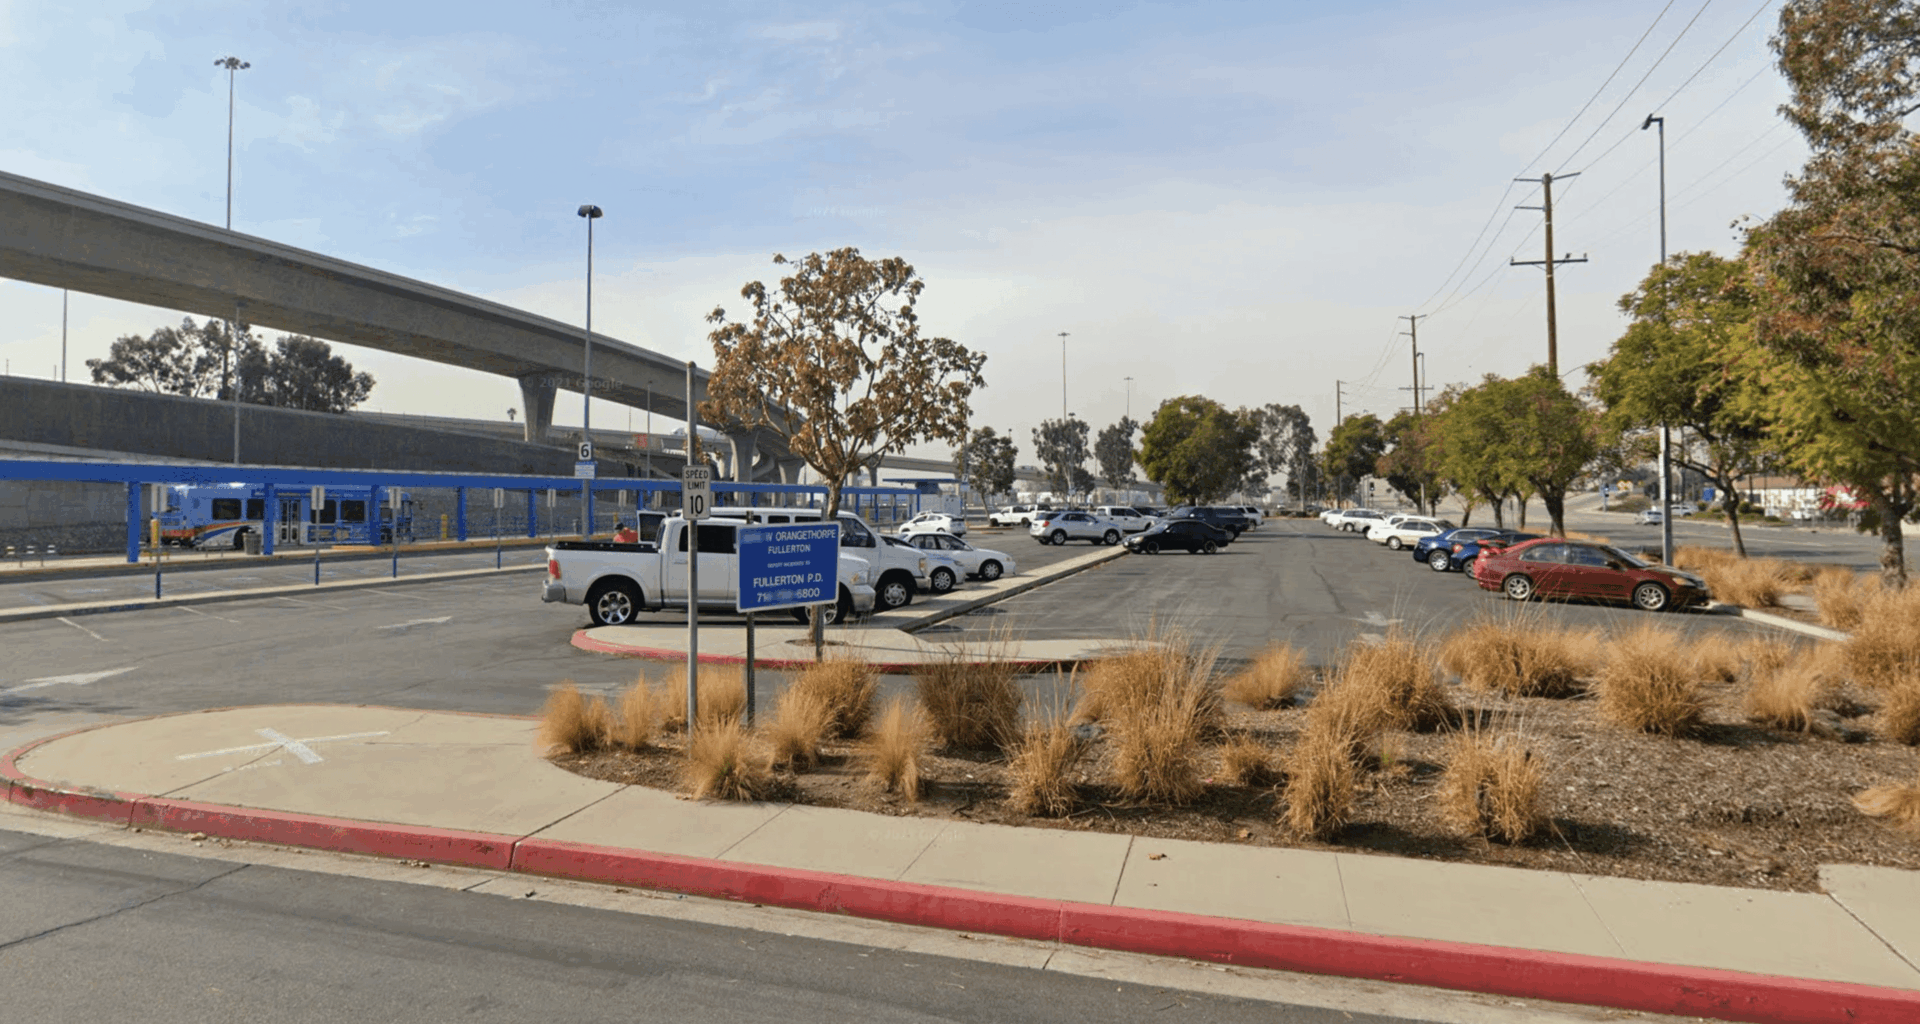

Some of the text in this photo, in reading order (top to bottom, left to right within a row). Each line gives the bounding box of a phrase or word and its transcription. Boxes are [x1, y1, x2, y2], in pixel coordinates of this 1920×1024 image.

[581, 444, 589, 458] 6
[685, 469, 709, 479] SPEED
[687, 481, 706, 490] LIMIT
[690, 495, 704, 515] 10
[775, 528, 837, 542] ORANGETHORPE
[767, 543, 811, 554] FULLERTON
[753, 572, 824, 588] FULLERTON P.D.
